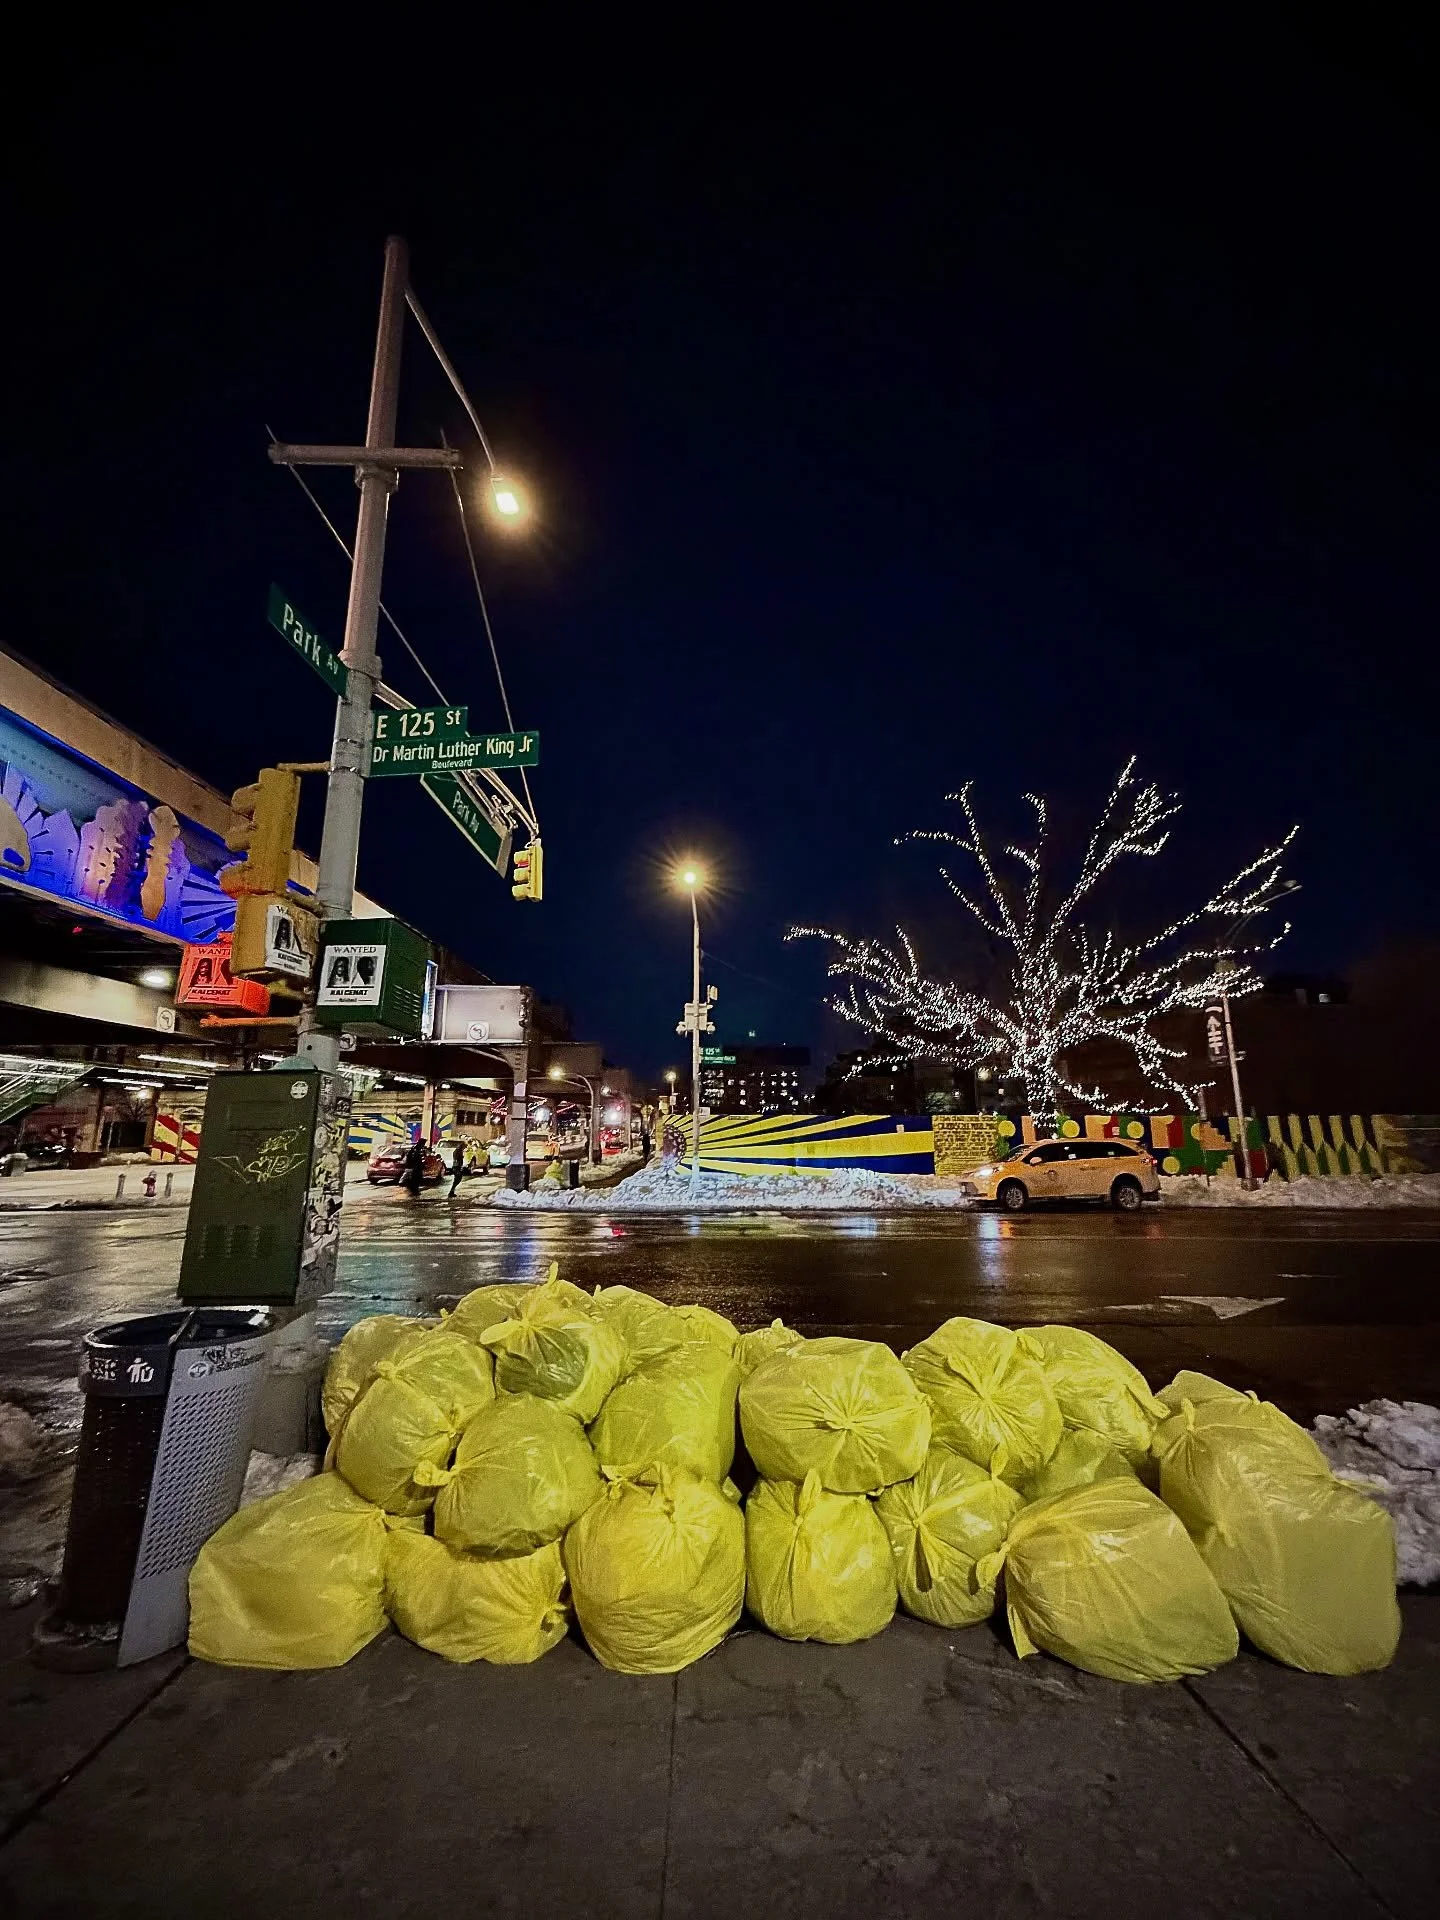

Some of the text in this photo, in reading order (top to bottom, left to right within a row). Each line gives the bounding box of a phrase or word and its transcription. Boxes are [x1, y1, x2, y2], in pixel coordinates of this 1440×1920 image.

[283, 603, 321, 667] Park
[376, 710, 461, 739] E 125 St
[372, 736, 533, 763] Dr Martin Luther King Jr
[431, 758, 473, 769] Boulevard
[334, 946, 377, 954] WANTED
